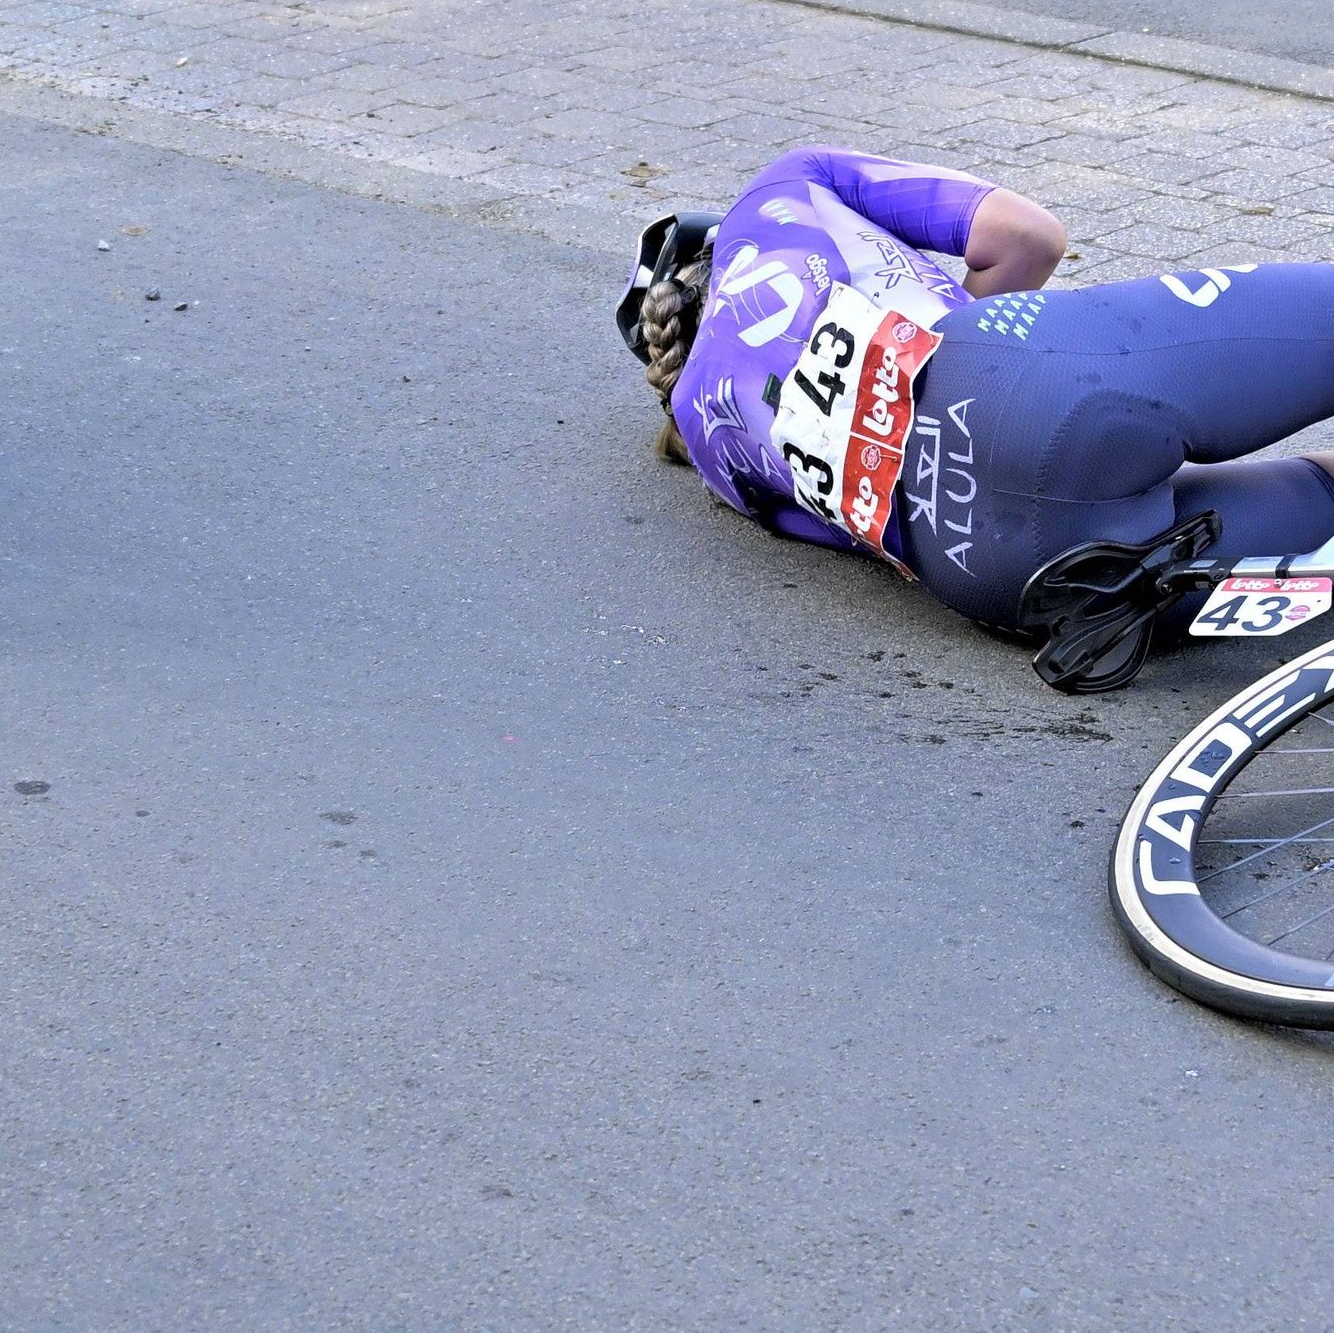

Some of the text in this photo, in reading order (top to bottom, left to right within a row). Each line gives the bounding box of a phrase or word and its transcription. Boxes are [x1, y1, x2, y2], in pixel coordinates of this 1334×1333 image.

[1012, 295, 1047, 341] MAAP
[793, 321, 855, 417] 43
[944, 398, 978, 578] ALULA
[1196, 595, 1292, 632] 43
